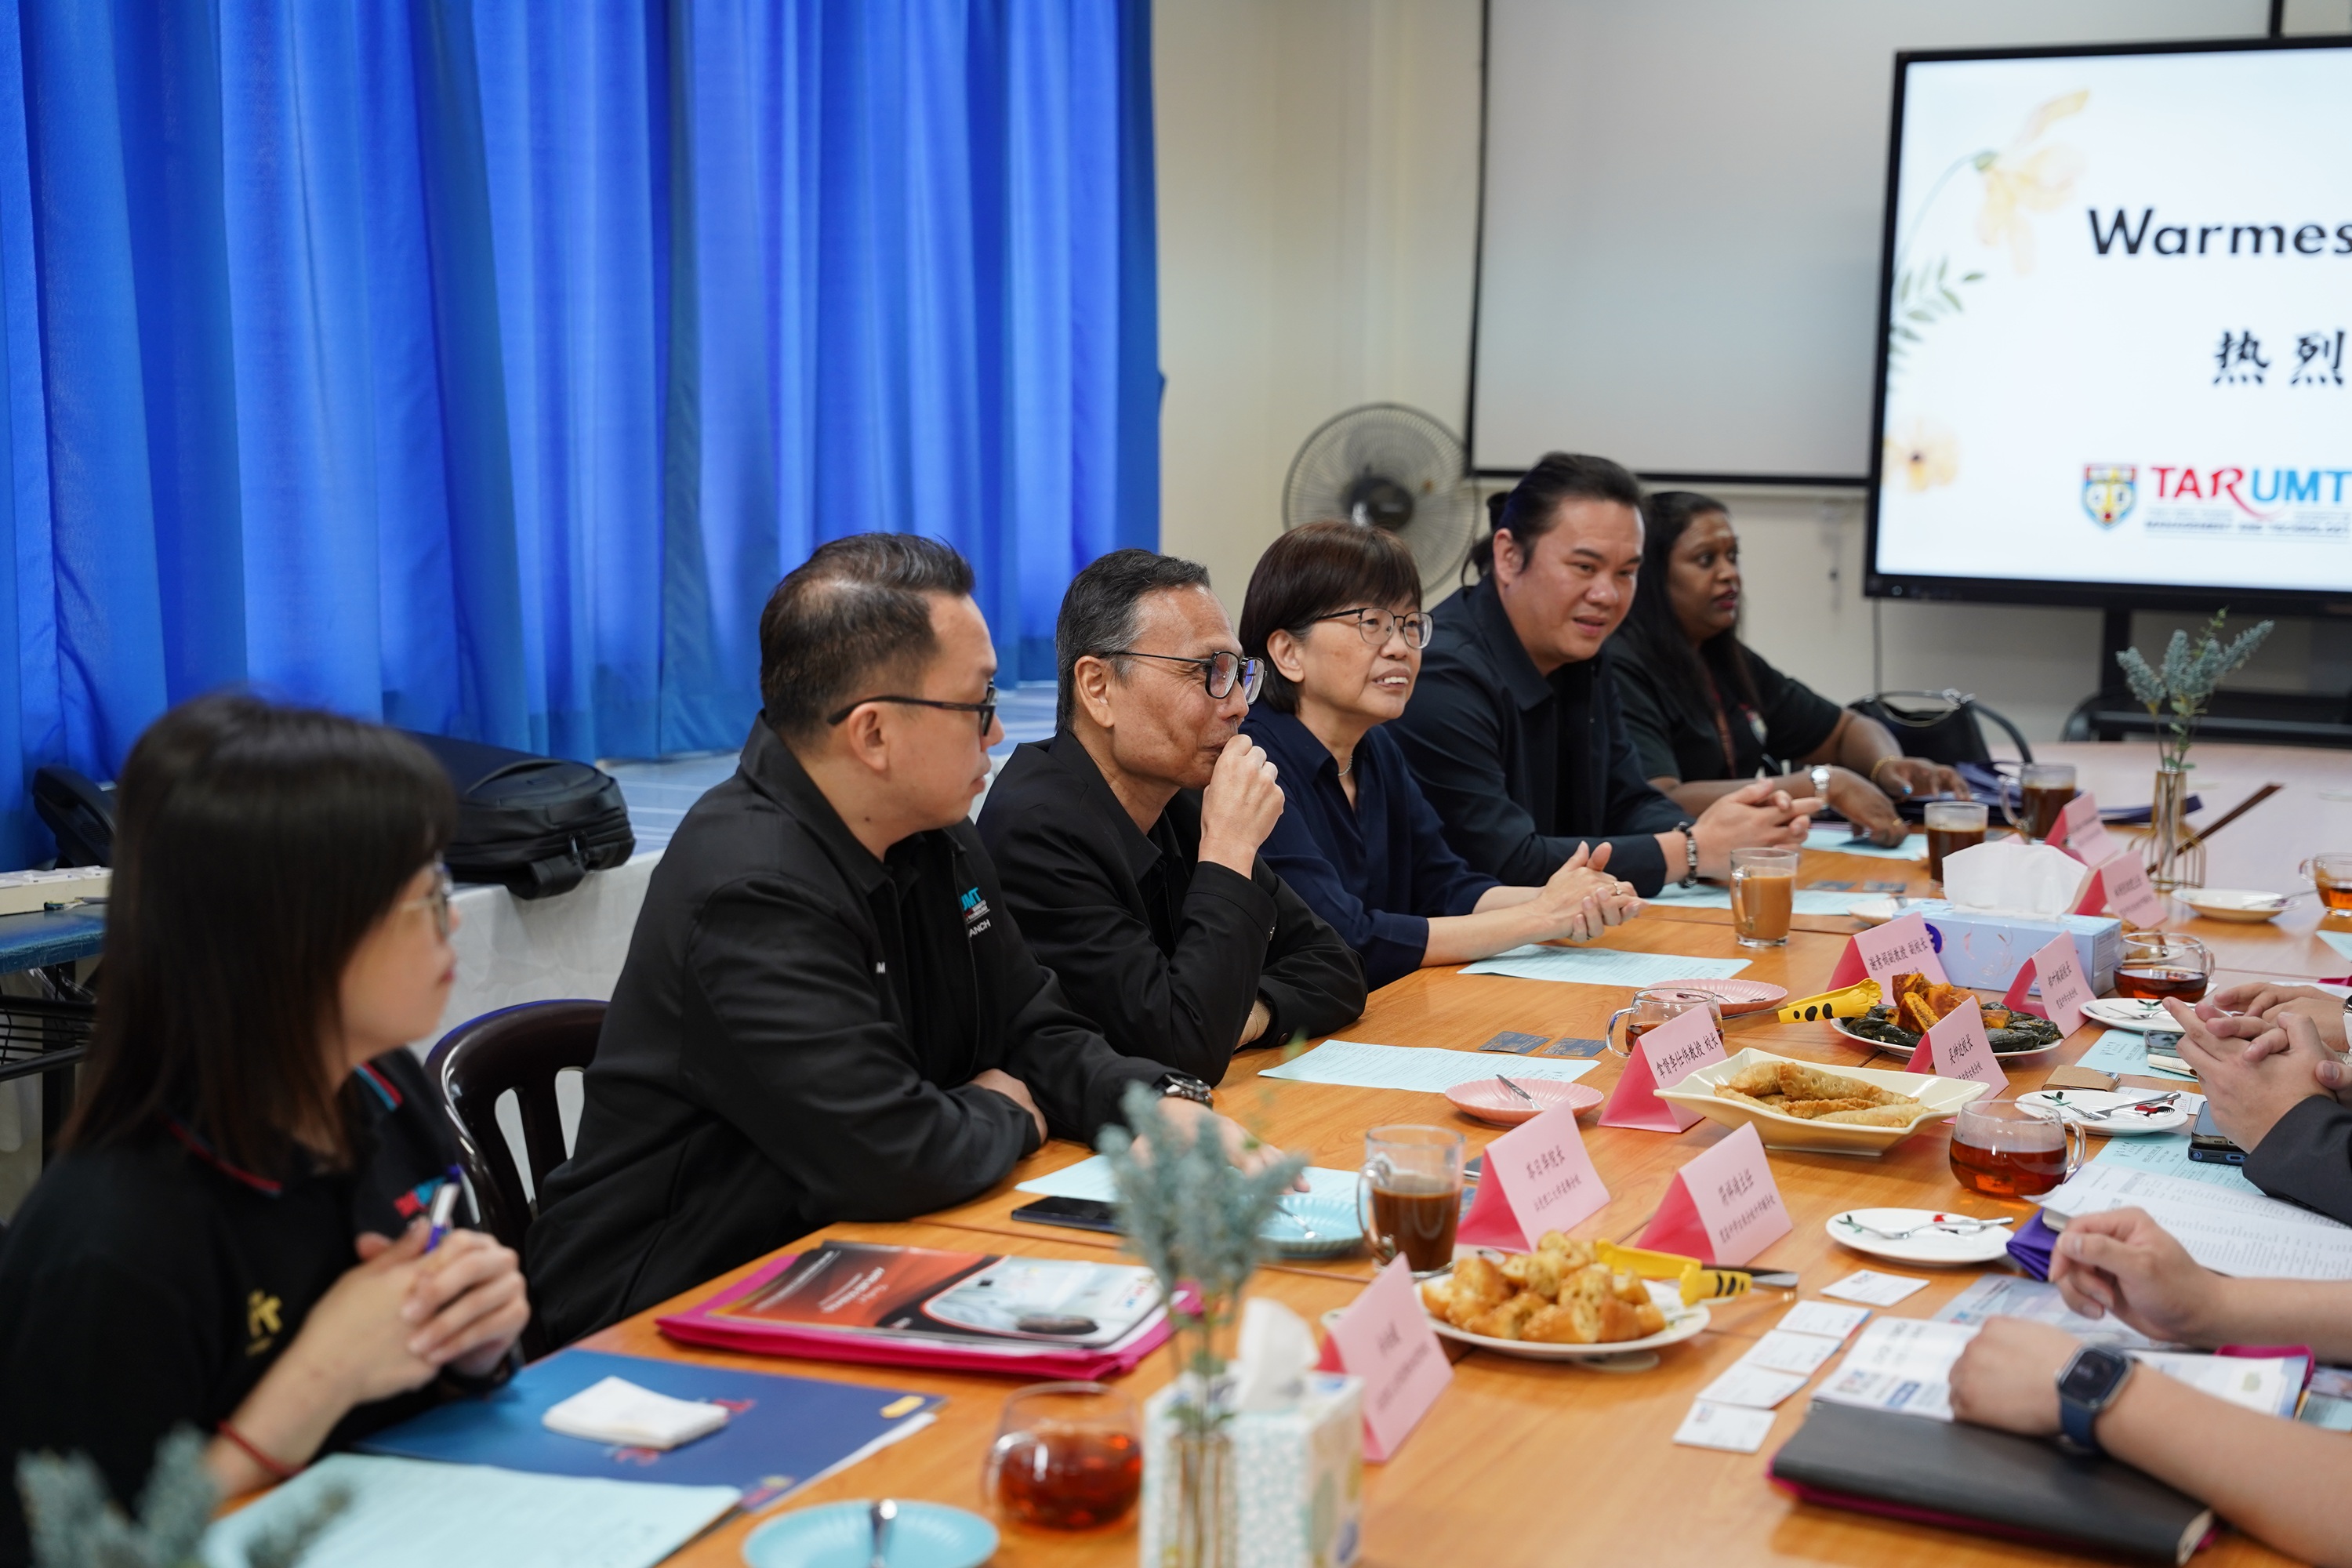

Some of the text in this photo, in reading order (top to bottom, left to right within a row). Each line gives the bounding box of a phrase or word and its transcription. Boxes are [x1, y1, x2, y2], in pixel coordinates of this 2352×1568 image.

[2087, 208, 2352, 256] Warmes
[2212, 329, 2347, 386] 热烈
[1655, 1032, 1719, 1080] 拿督李仕伟教授 校长
